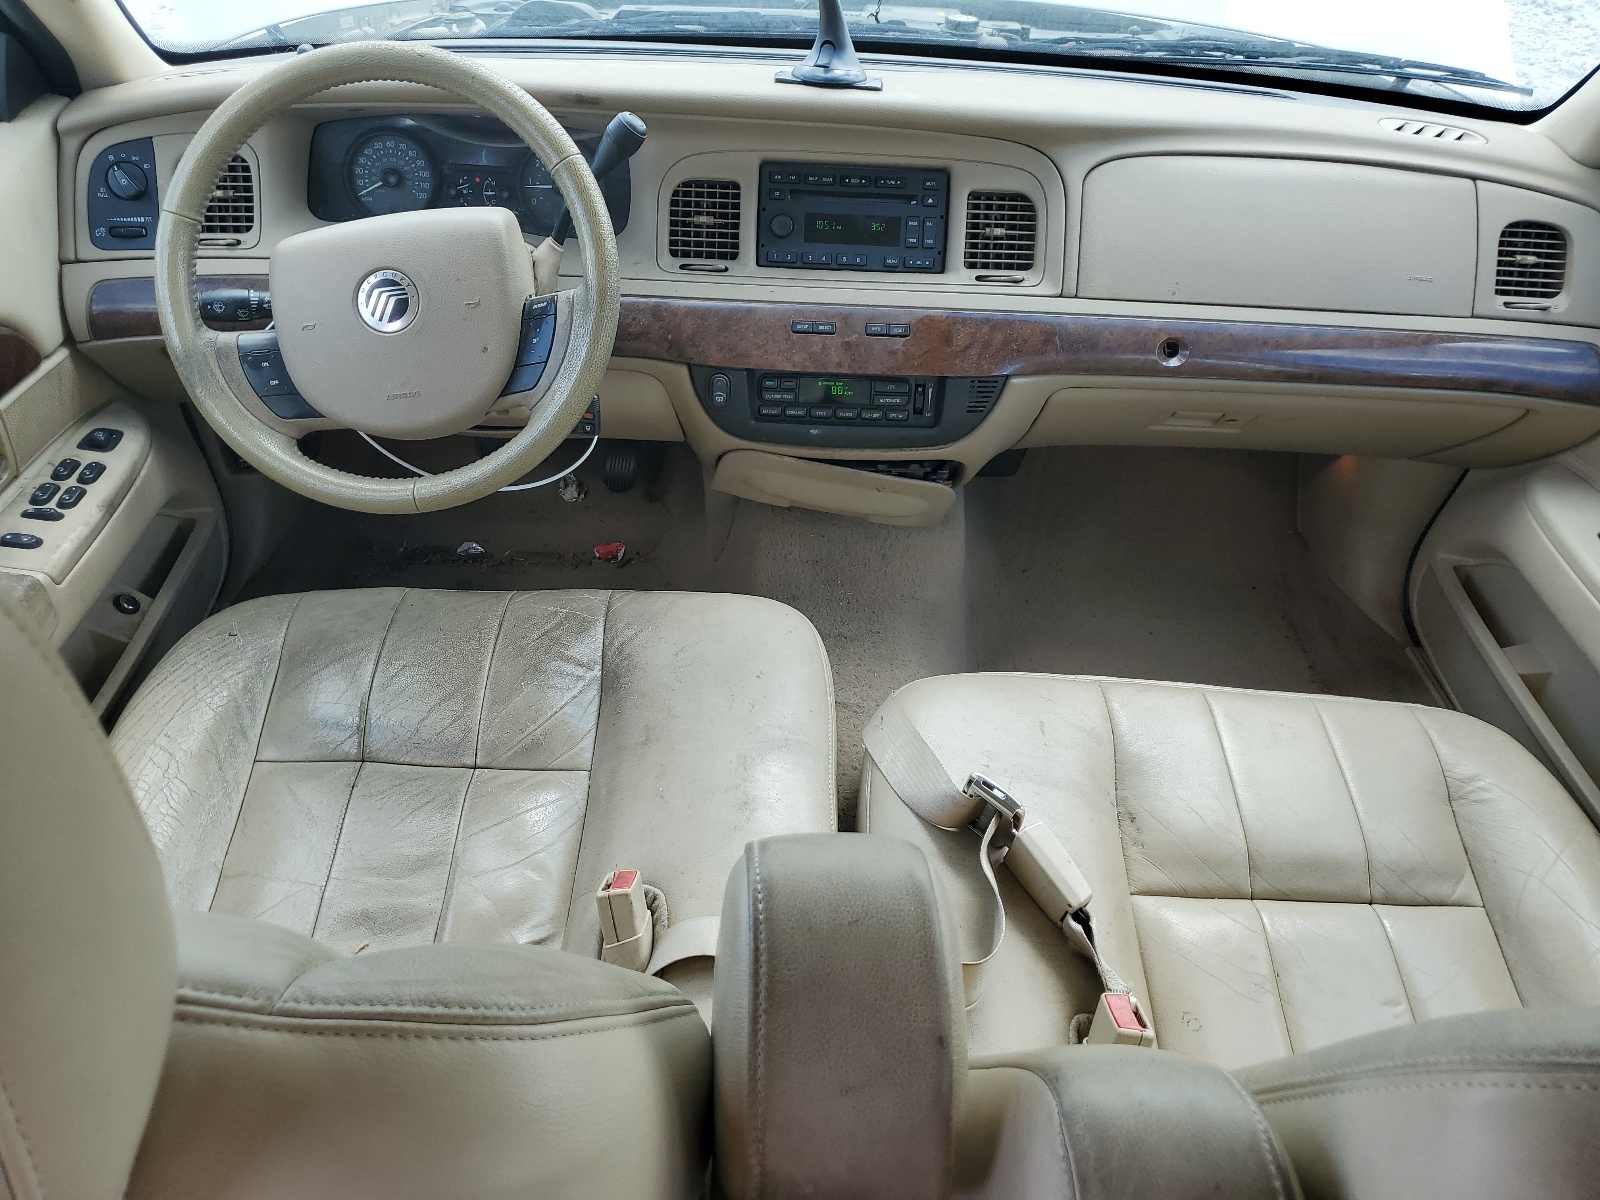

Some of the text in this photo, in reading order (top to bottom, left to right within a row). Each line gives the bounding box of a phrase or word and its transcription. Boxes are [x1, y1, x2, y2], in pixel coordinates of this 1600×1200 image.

[535, 159, 540, 167] 2
[418, 170, 430, 178] 100
[361, 271, 412, 293] MERCURY
